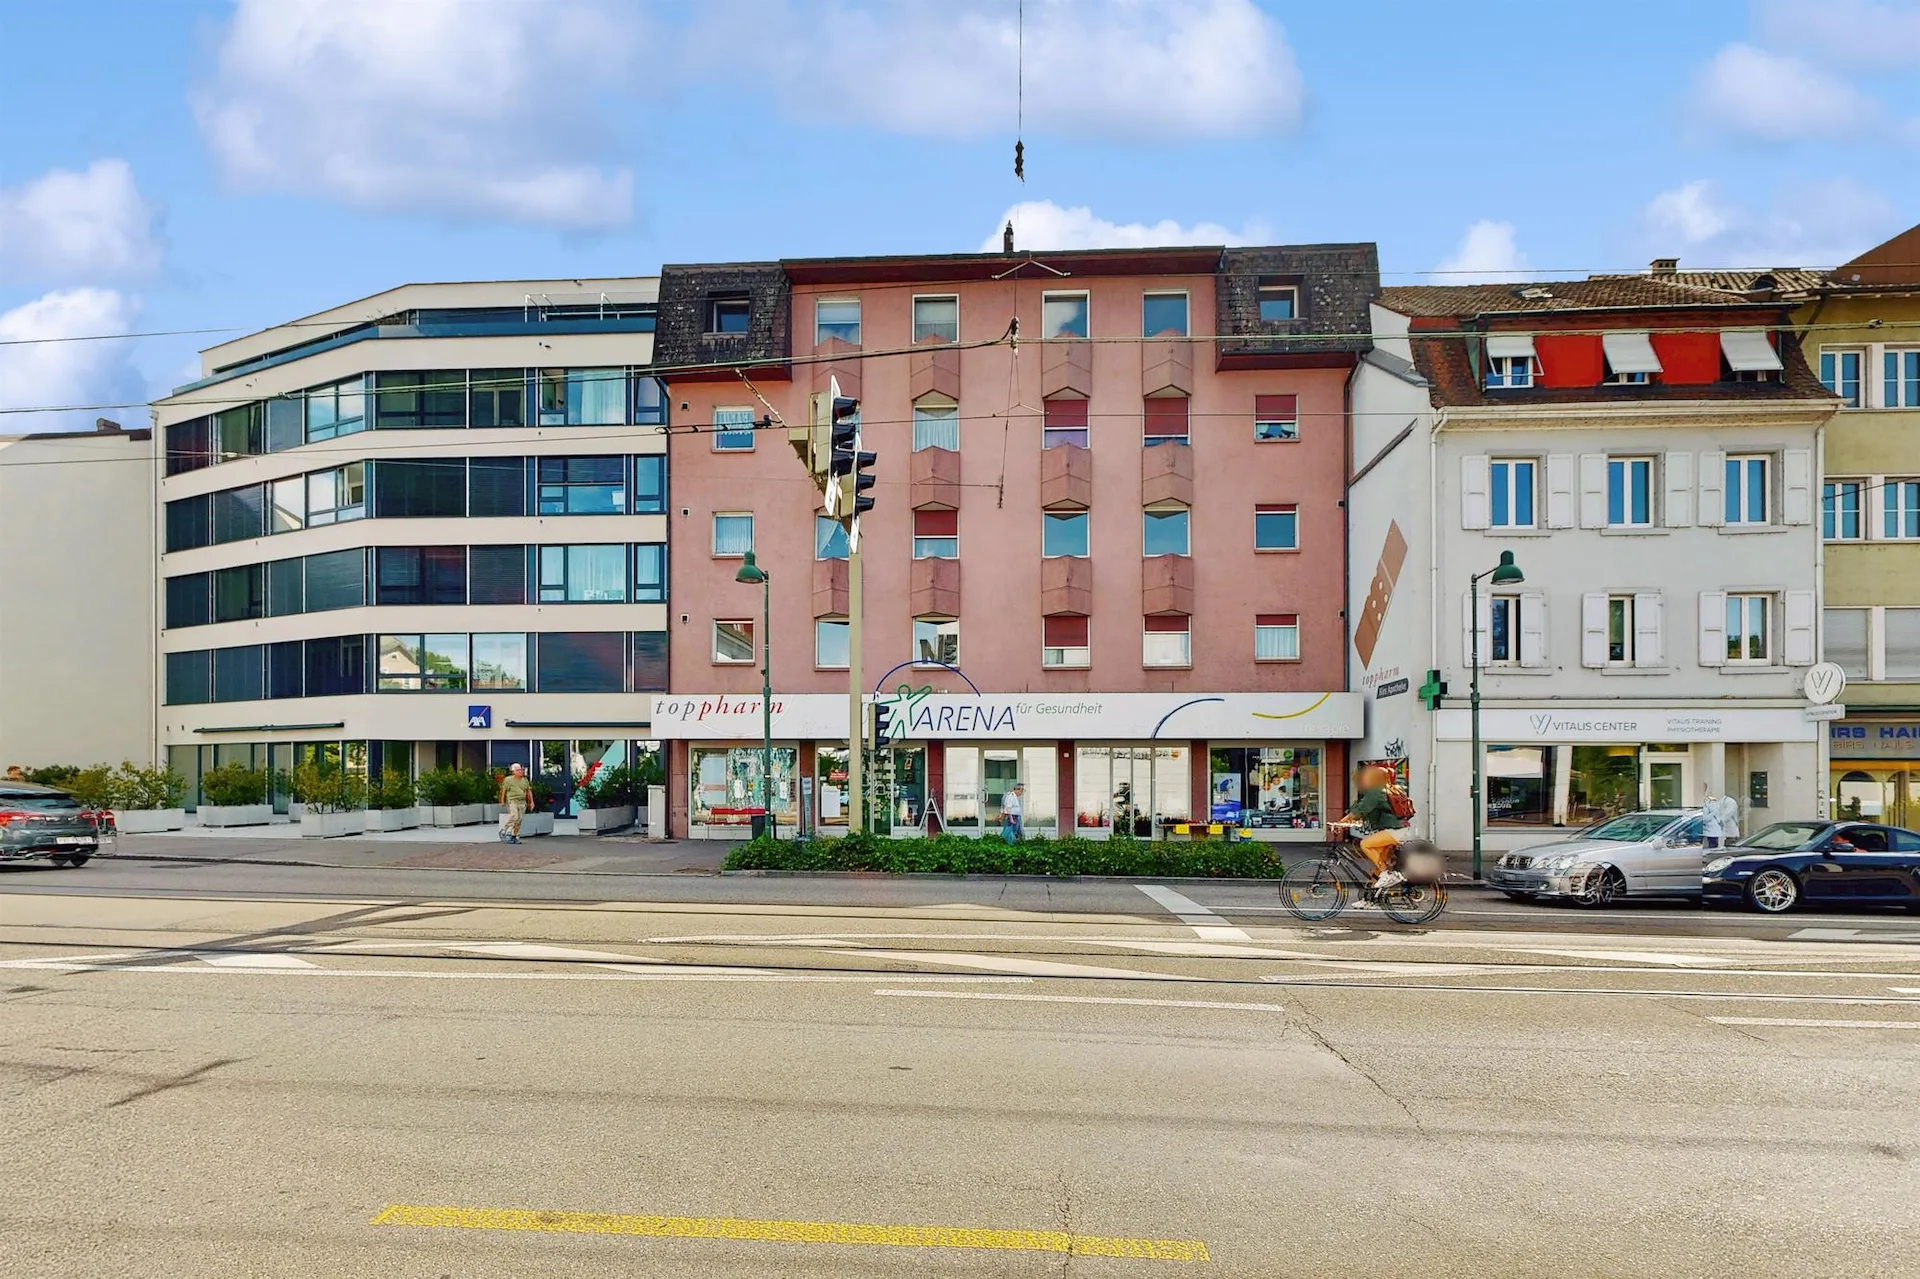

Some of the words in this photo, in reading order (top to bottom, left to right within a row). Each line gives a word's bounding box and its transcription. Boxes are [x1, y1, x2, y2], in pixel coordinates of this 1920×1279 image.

[656, 694, 783, 722] toppharm
[468, 716, 486, 727] AXA
[912, 706, 1016, 731] ARENA
[1015, 702, 1034, 715] für
[1036, 702, 1103, 715] Gesundheit
[1553, 722, 1592, 731] VITALIS
[1594, 722, 1637, 731] CENTER
[1832, 727, 1866, 738] IRS
[1880, 727, 1920, 738] HAI
